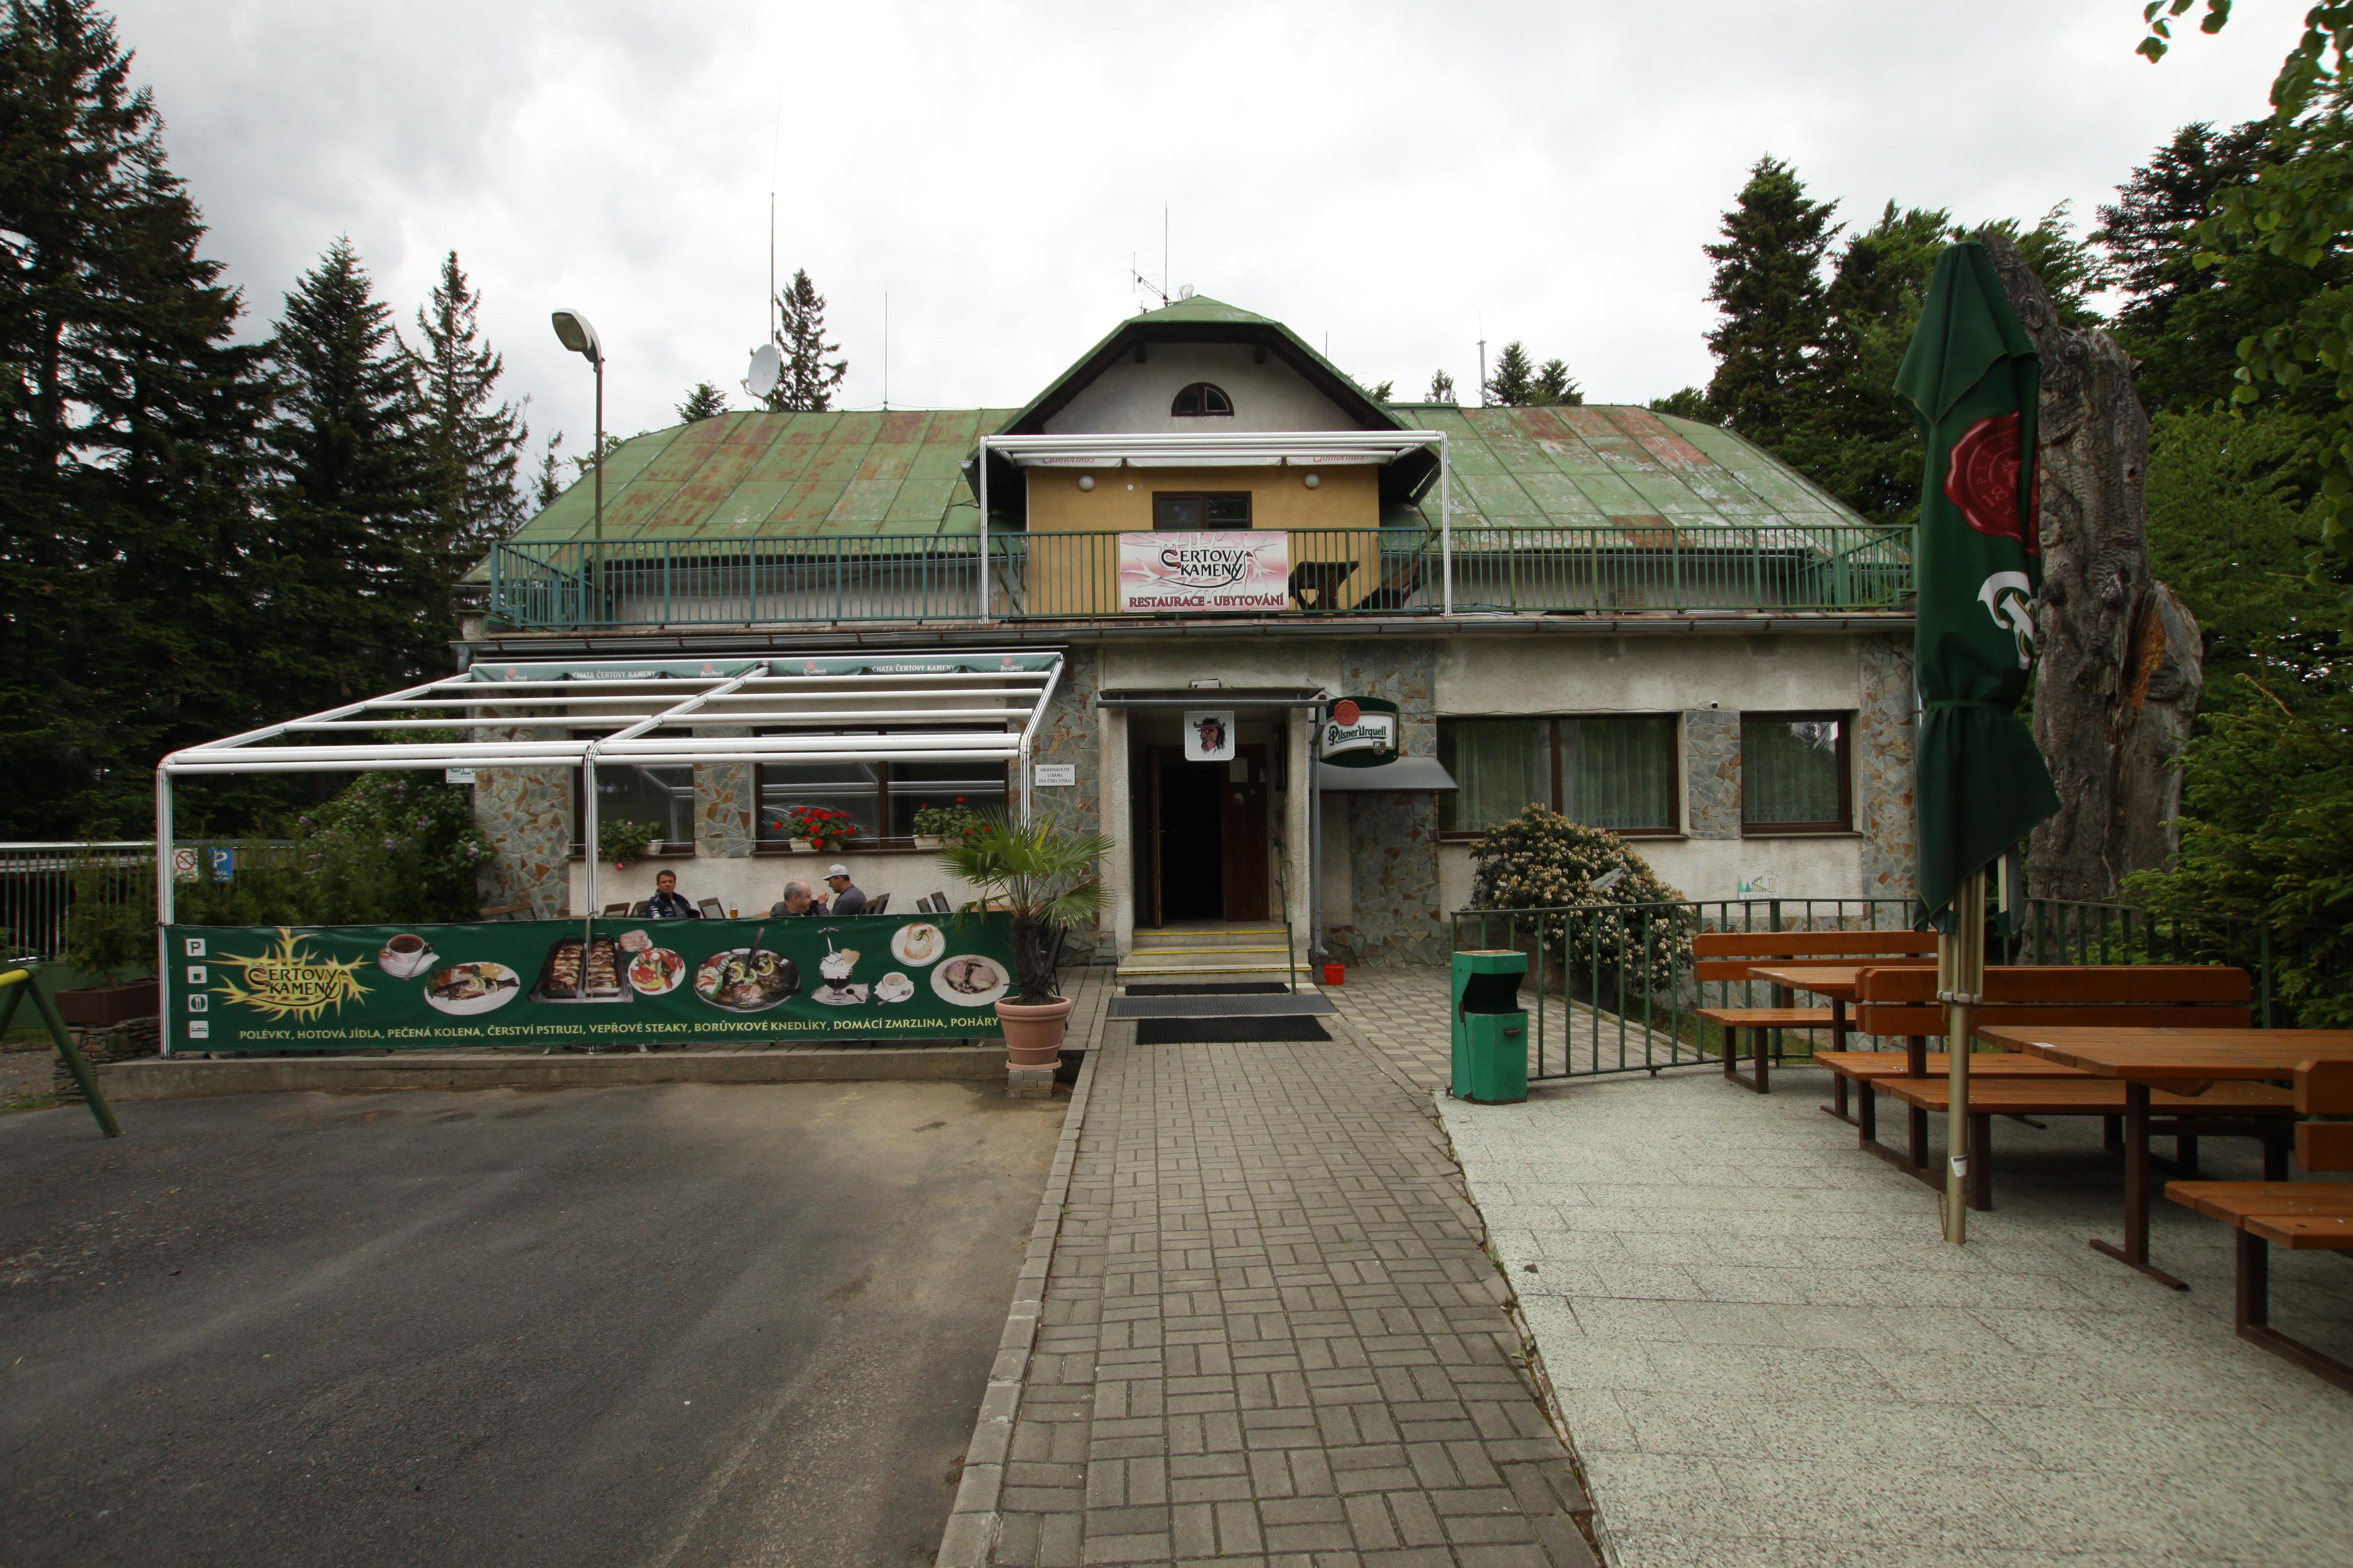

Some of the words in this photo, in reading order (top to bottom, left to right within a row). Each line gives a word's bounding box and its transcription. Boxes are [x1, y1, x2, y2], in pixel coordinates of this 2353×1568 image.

[1180, 563, 1244, 581] KAMENY
[1129, 595, 1205, 608] RESTAURACE
[1214, 593, 1284, 606] UBYTOVÁNÍ
[596, 670, 625, 678] ČERTOVY
[895, 663, 925, 672] ČERTOVY
[1328, 725, 1358, 746] Pilsner
[1358, 725, 1387, 740] Urquell
[191, 941, 201, 953] P
[270, 982, 338, 999] KAMENY
[240, 1029, 295, 1040] POLÉVKY,
[297, 1028, 346, 1039] HOTOVÁ
[349, 1027, 385, 1039] JÍDLA,
[388, 1026, 432, 1038] PEČENÁ
[435, 1027, 485, 1037] KOLENA,
[488, 1024, 534, 1036] ČERSTVÍ
[536, 1025, 586, 1035] PSTRUZI,
[589, 1022, 643, 1033] VEPŘOVÉ
[645, 1023, 692, 1034] STEAKY,
[694, 1020, 768, 1032] BORŮVKOVÉ
[771, 1019, 831, 1031] KNEDLÍKY,
[834, 1017, 882, 1030] DOMÁCÍ
[885, 1018, 948, 1029] ZMRZLINA,
[951, 1016, 999, 1027] POHÁRY
